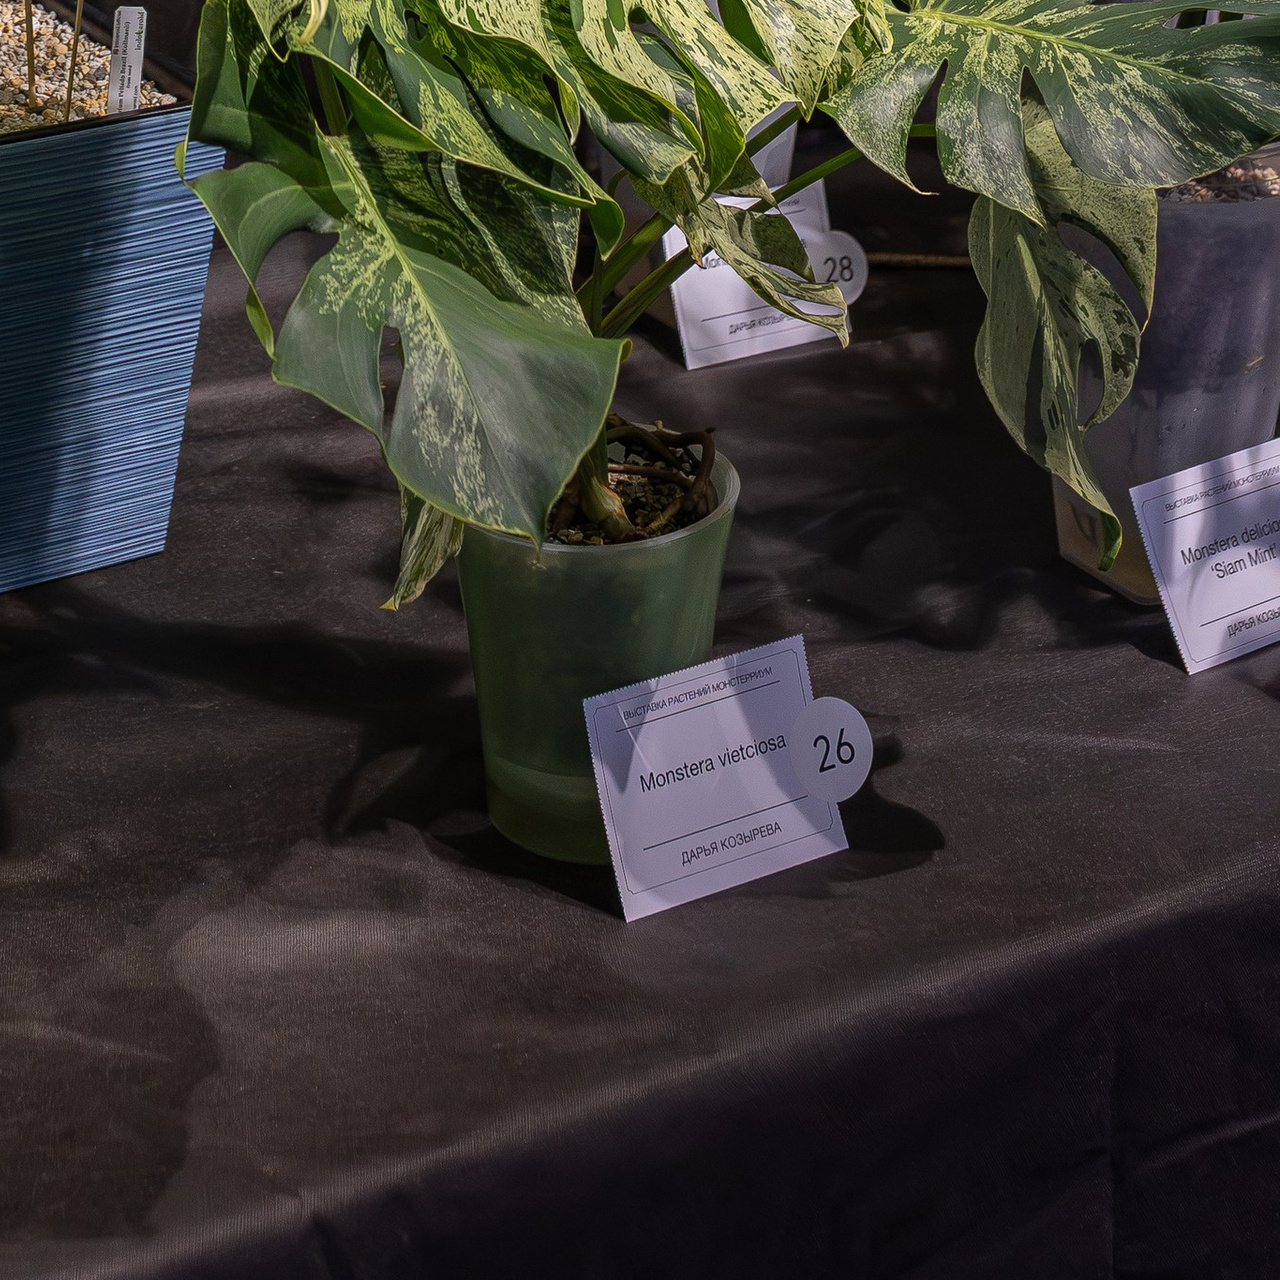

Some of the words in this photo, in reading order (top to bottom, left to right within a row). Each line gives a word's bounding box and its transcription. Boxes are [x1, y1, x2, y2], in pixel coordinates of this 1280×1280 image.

[824, 256, 854, 283] 28
[1180, 535, 1240, 565] Monstera
[1241, 519, 1280, 543] delicio
[1227, 616, 1257, 637] ДАРЬЯ
[623, 697, 667, 721] ВЫСТАВКА
[667, 683, 711, 707] РАСТЕНИЙ
[712, 666, 773, 693] МОНСТЕРРИУМ
[639, 757, 715, 793] Monstera
[718, 733, 787, 767] vietciosa
[812, 727, 856, 774] 26
[681, 841, 719, 867] ДАРЬЯ
[721, 821, 782, 851] КОЗЫРЕВА
